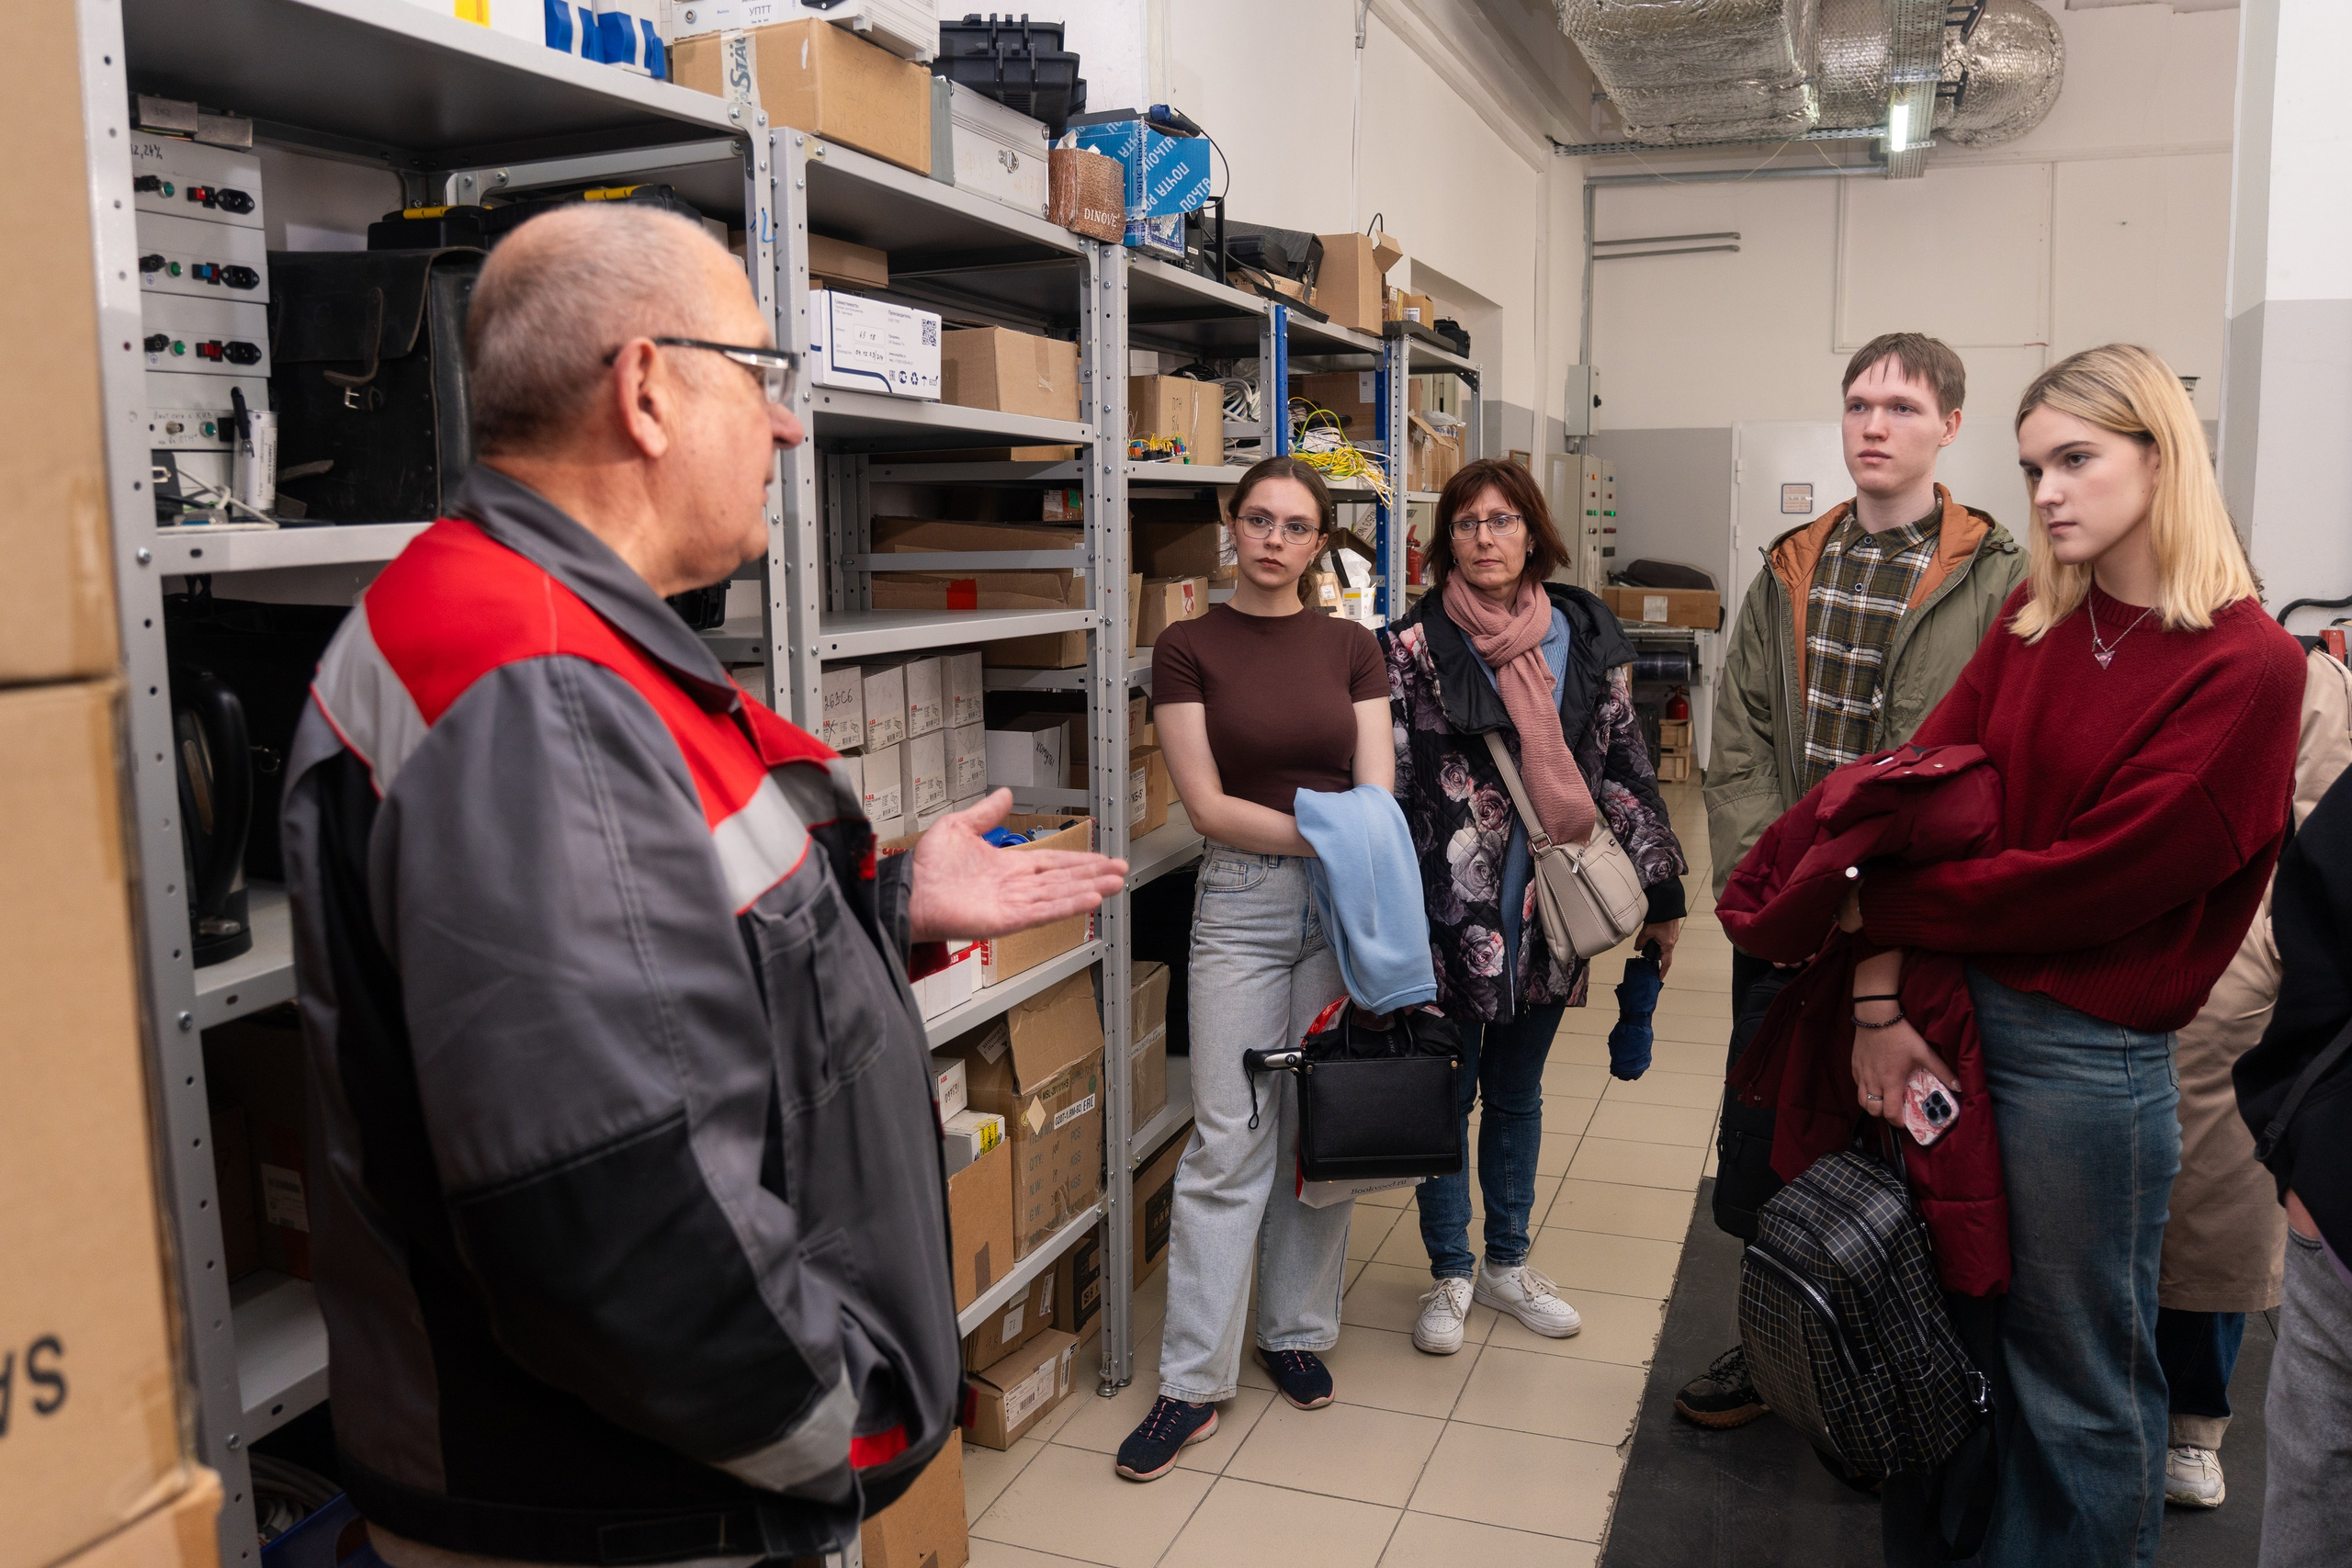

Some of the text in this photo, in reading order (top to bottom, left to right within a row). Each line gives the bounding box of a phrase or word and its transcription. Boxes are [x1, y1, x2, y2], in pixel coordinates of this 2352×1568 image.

[749, 5, 772, 16] УПТТ
[1154, 162, 1190, 197] ПОЧТА
[1180, 177, 1211, 212] ПОЧТА
[1084, 208, 1118, 228] DINOVE
[950, 954, 959, 964] ABB
[1387, 1034, 1396, 1053] ZICCO
[1070, 1126, 1080, 1142] PCS
[1351, 1179, 1407, 1194] Bookvoed.ru
